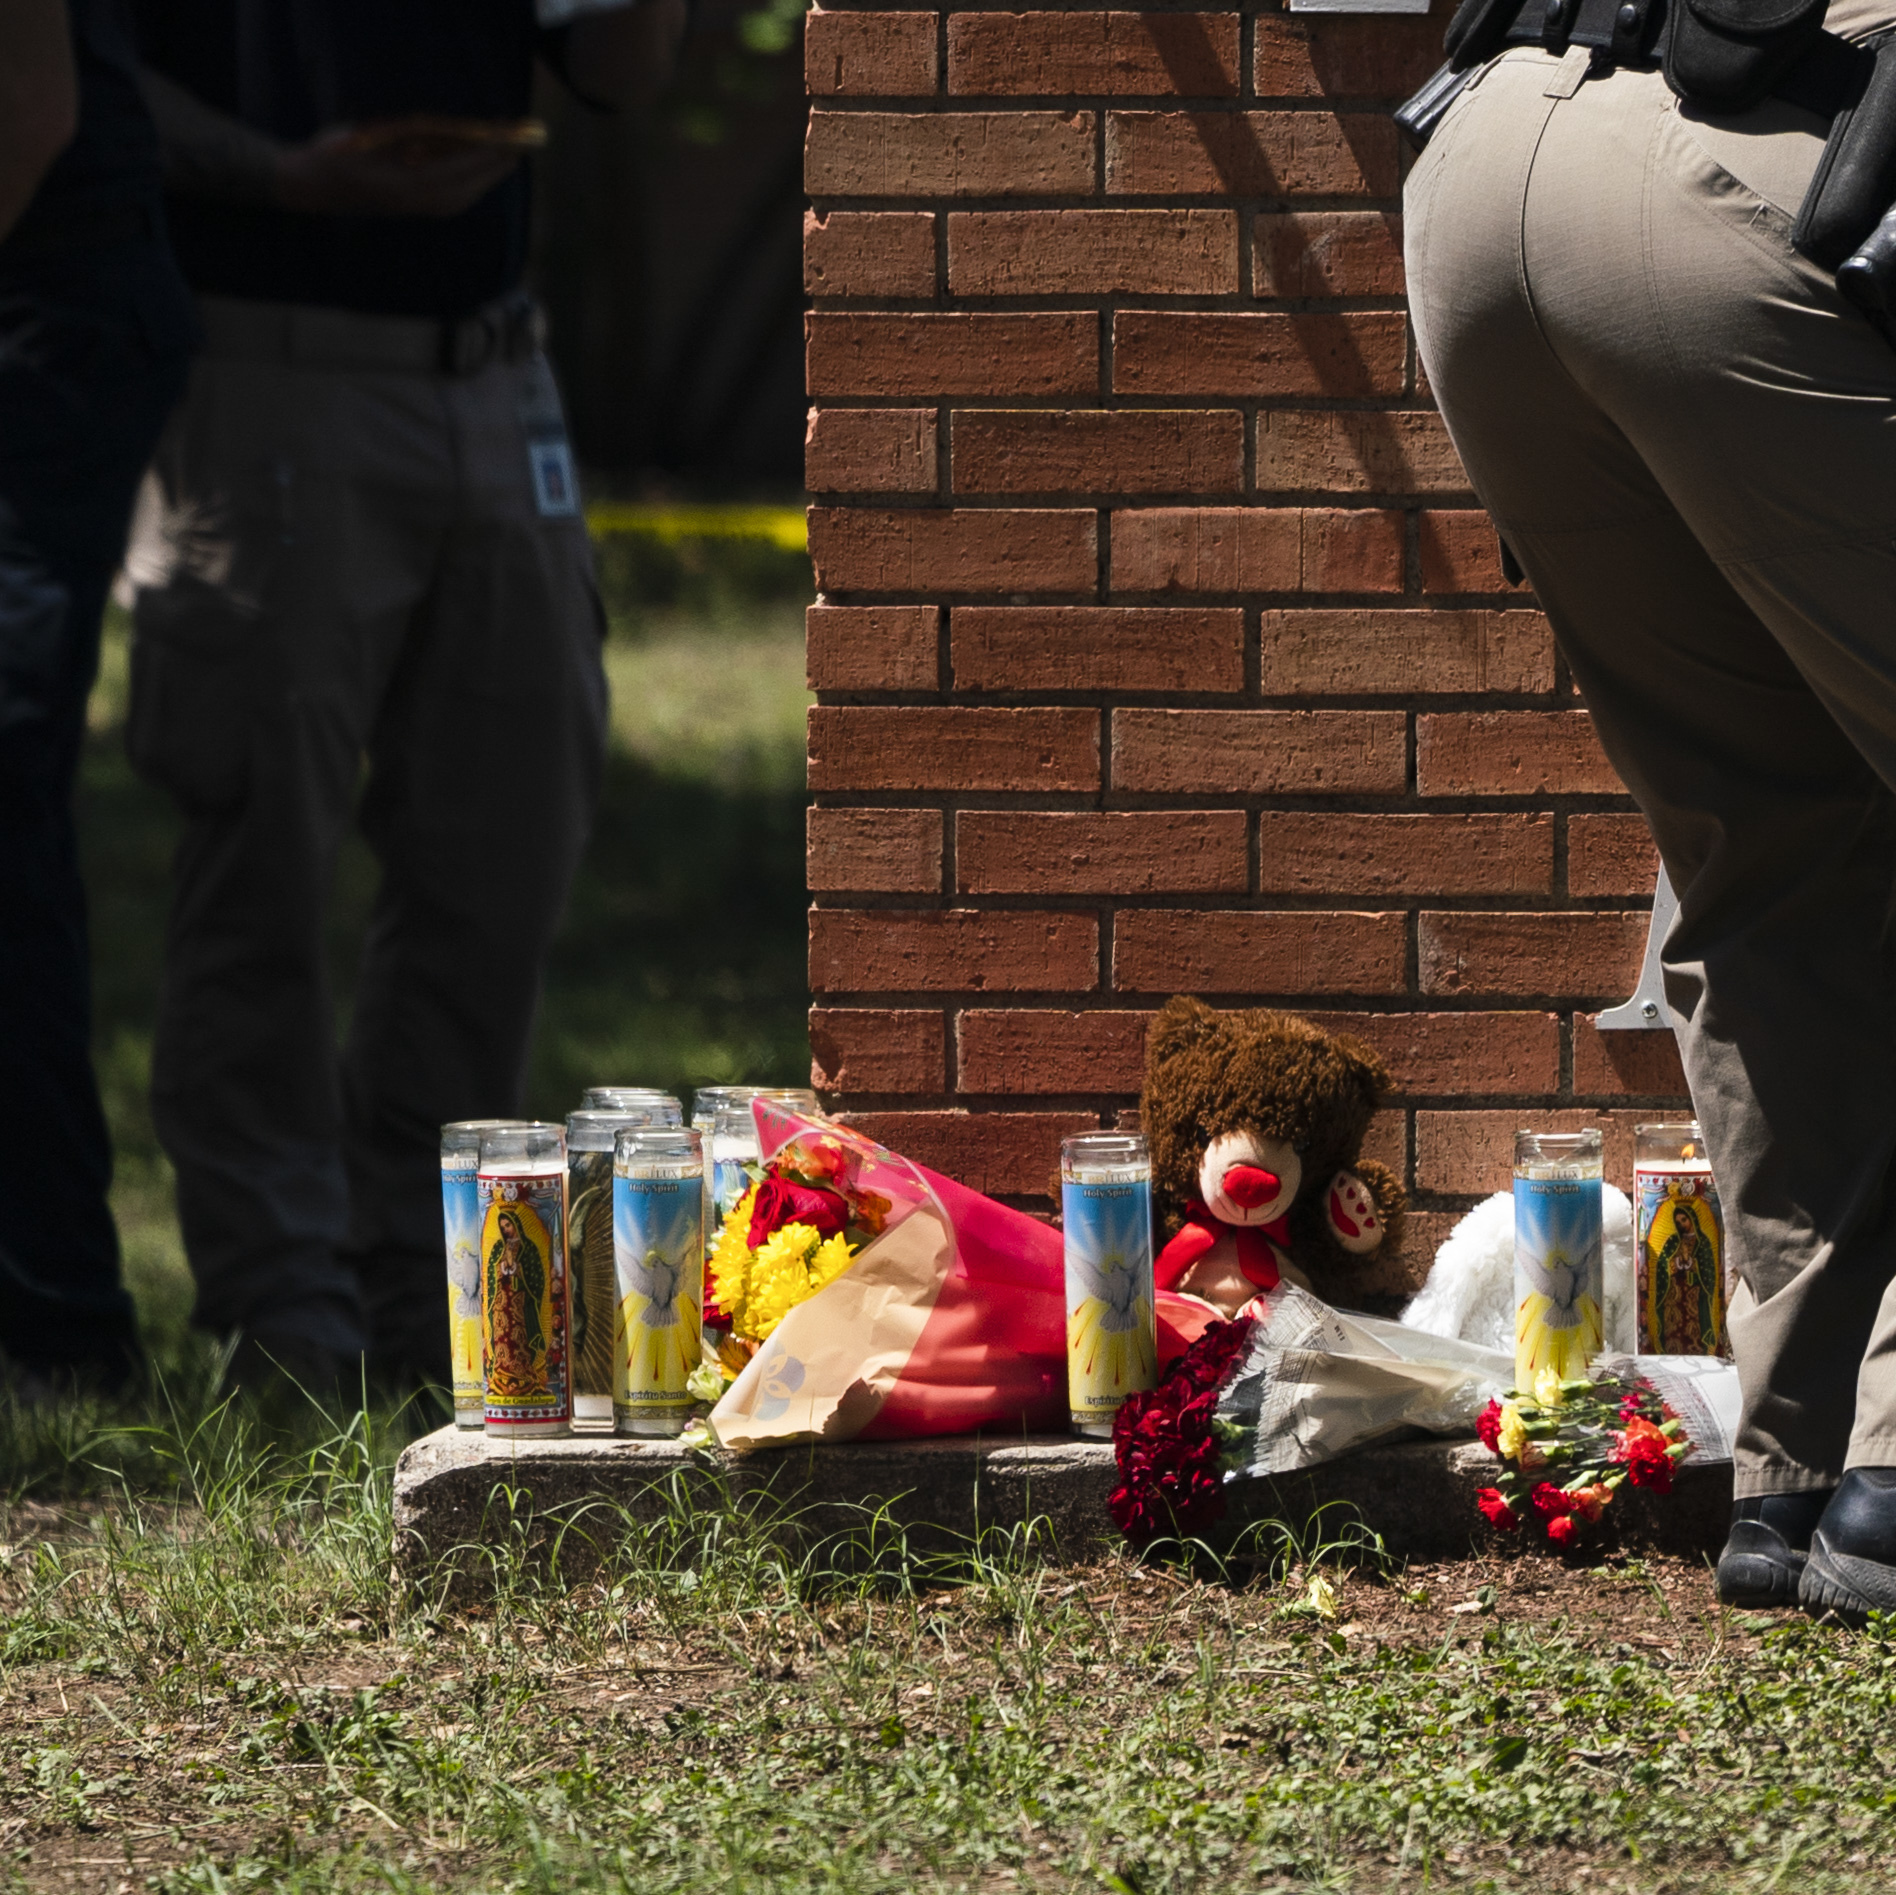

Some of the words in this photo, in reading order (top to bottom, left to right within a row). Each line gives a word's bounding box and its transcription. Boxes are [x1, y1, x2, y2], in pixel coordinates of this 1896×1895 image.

[629, 1182, 650, 1194] Holy
[651, 1182, 679, 1194] Spirit
[1083, 1188, 1105, 1200] Holy
[1106, 1187, 1133, 1200] Spirit
[1530, 1184, 1551, 1194] Holy
[1553, 1184, 1580, 1195] Spirit
[660, 1390, 687, 1400] Santo
